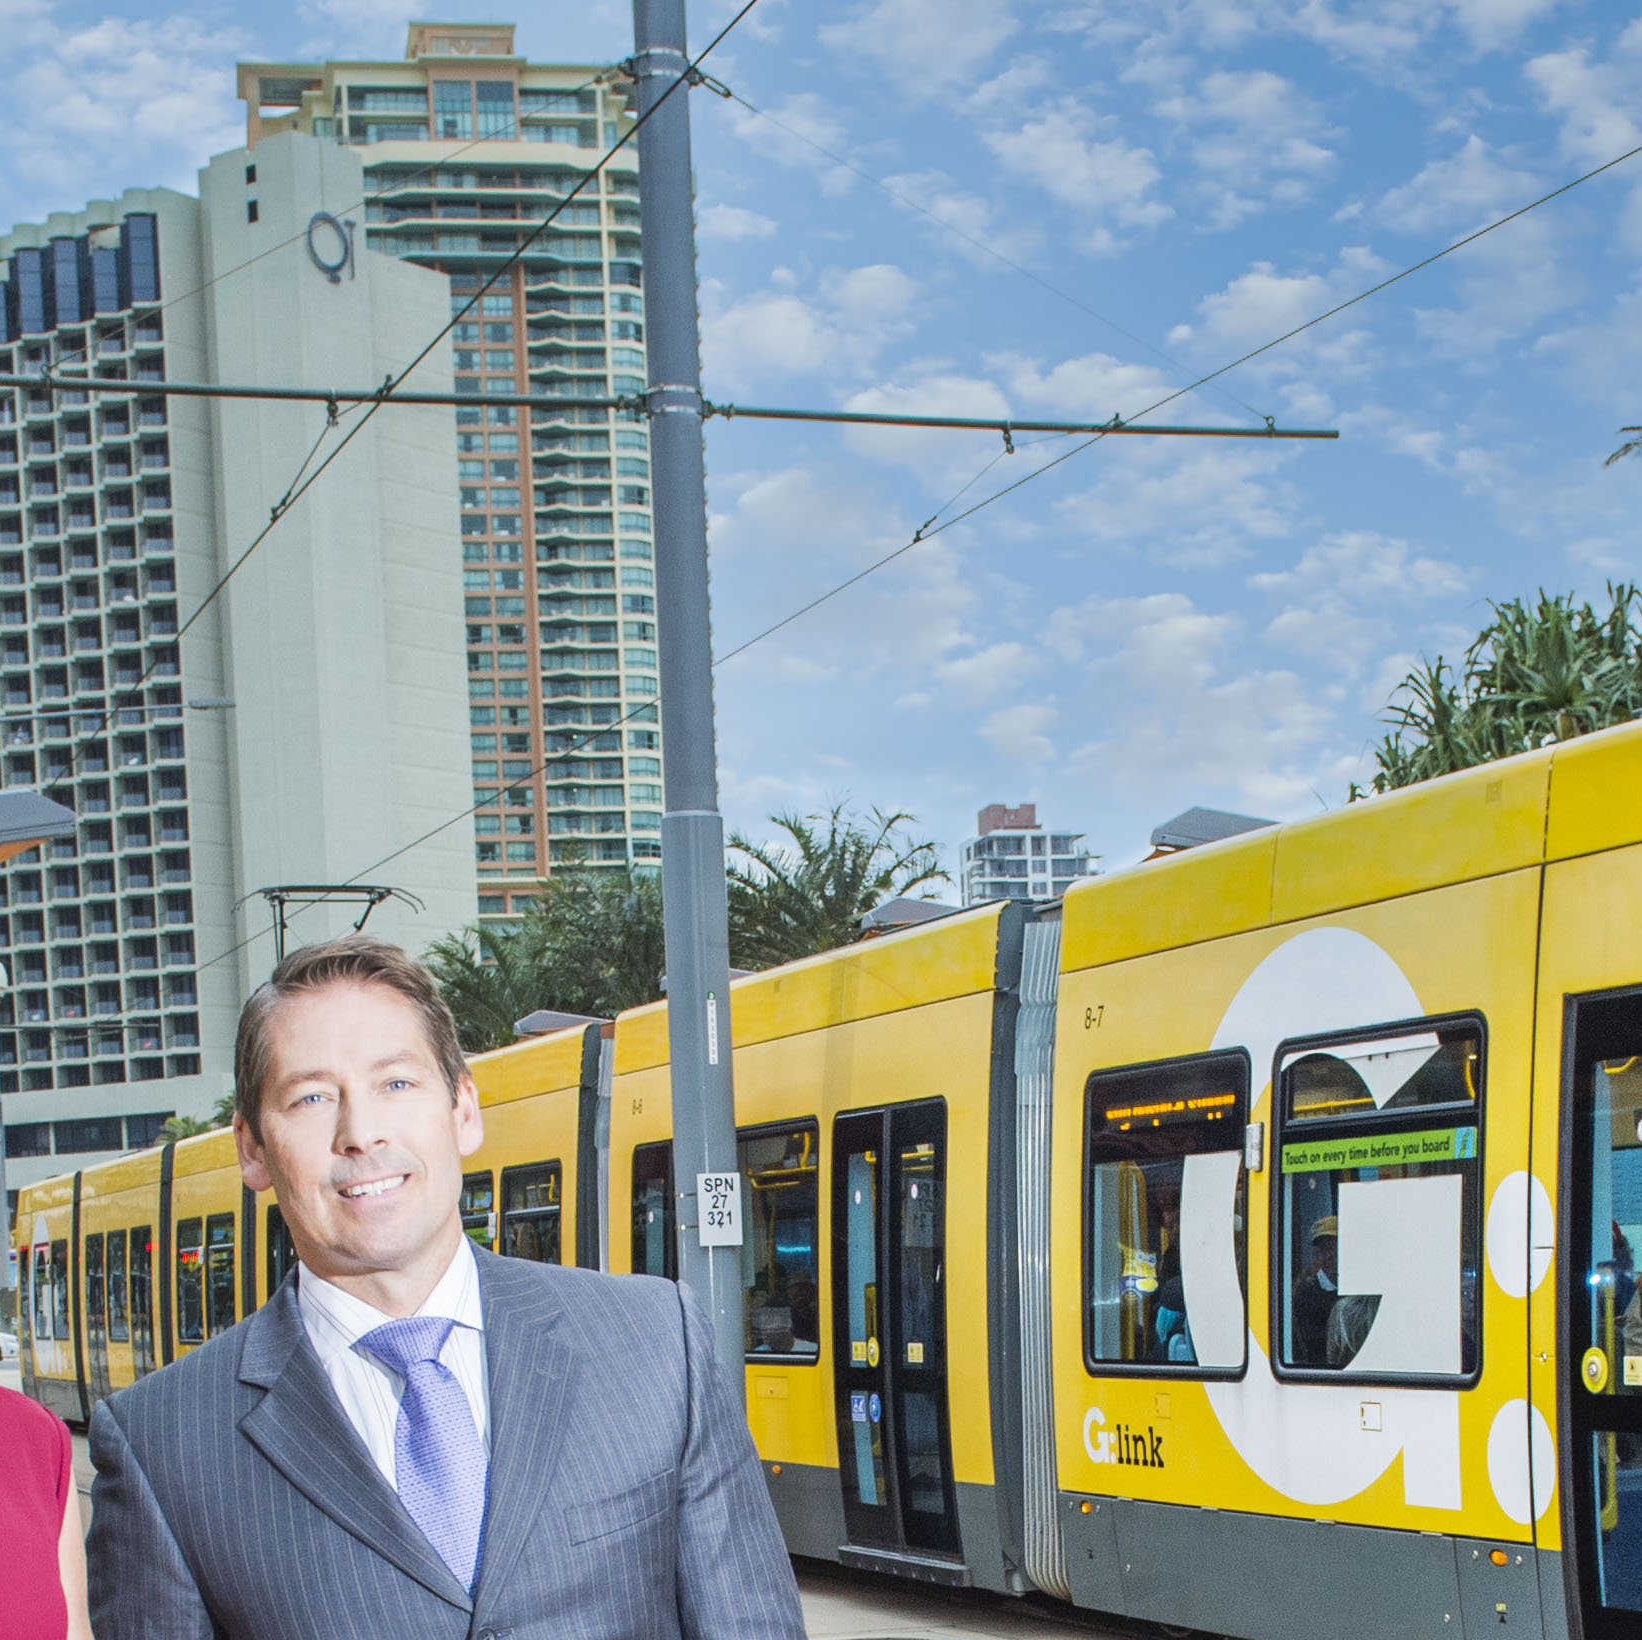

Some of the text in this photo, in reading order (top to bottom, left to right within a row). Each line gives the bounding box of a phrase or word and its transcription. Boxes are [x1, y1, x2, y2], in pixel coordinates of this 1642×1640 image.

[1085, 1005, 1104, 1029] 8-7
[1285, 1136, 1450, 1166] Touch on every time before you board
[704, 1178, 734, 1193] SPN
[712, 1194, 728, 1209] 27
[707, 1211, 732, 1226] 321
[1083, 1406, 1165, 1468] G:link
